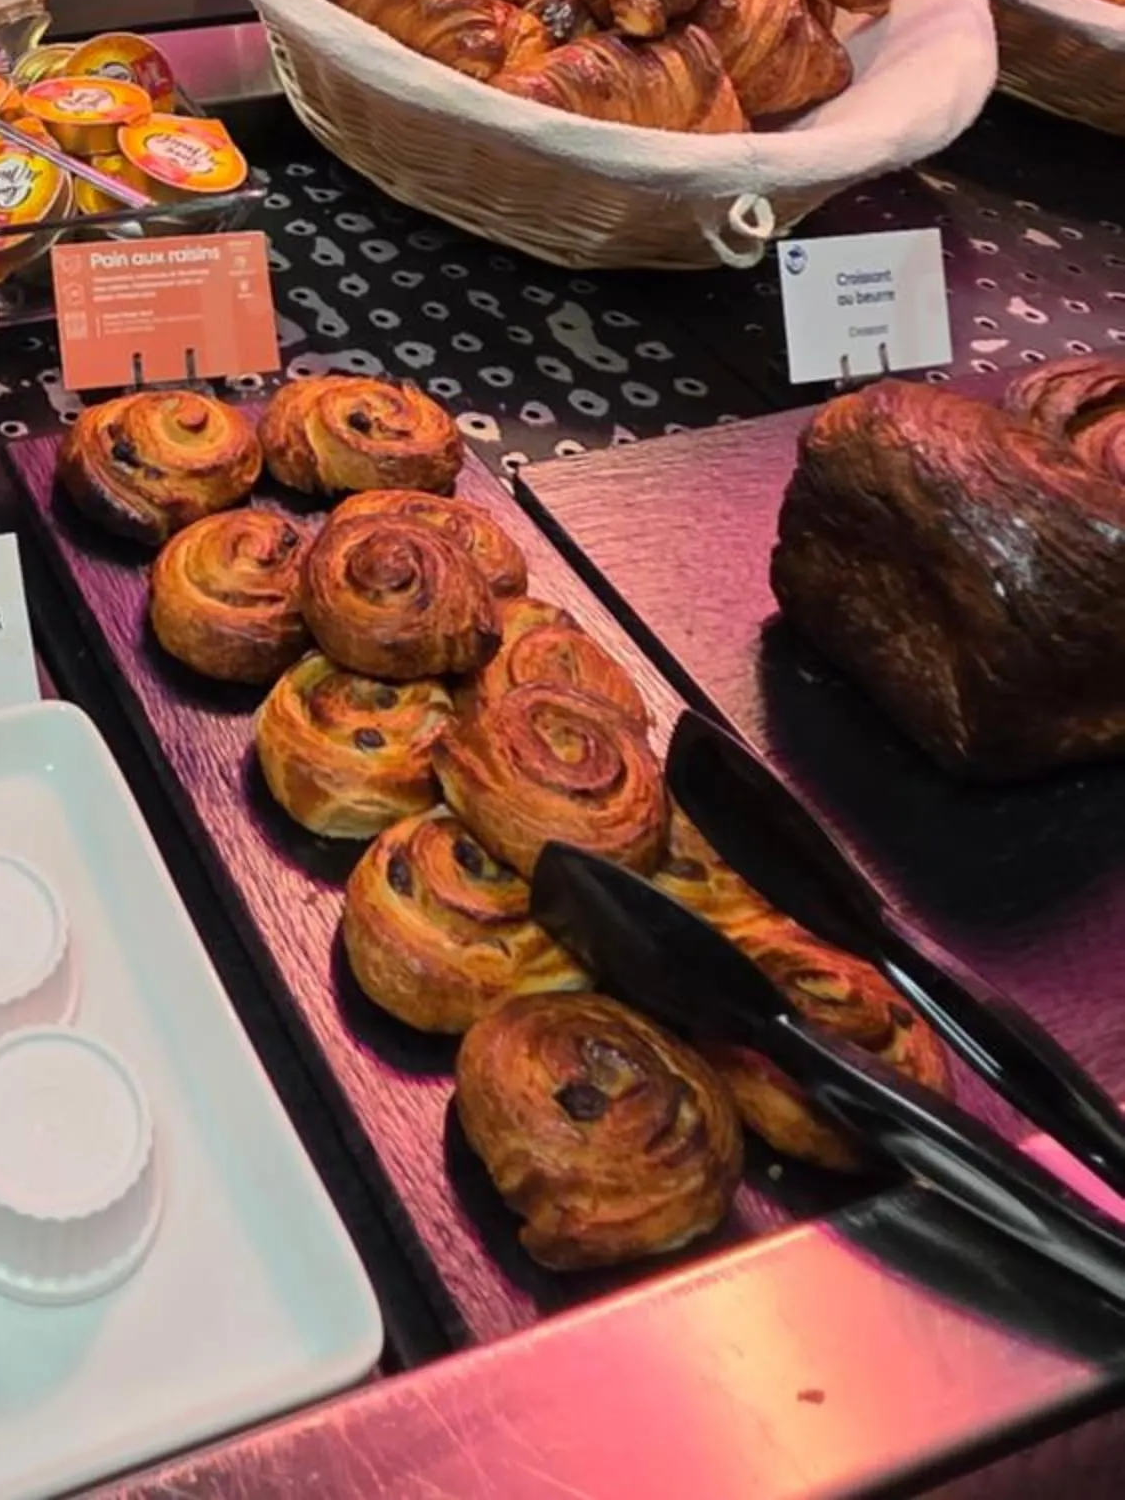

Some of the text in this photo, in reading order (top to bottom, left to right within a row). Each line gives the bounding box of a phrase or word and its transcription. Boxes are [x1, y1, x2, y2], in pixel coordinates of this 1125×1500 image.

[90, 251, 128, 269] Pain
[131, 250, 165, 266] aux
[168, 245, 221, 262] raisins
